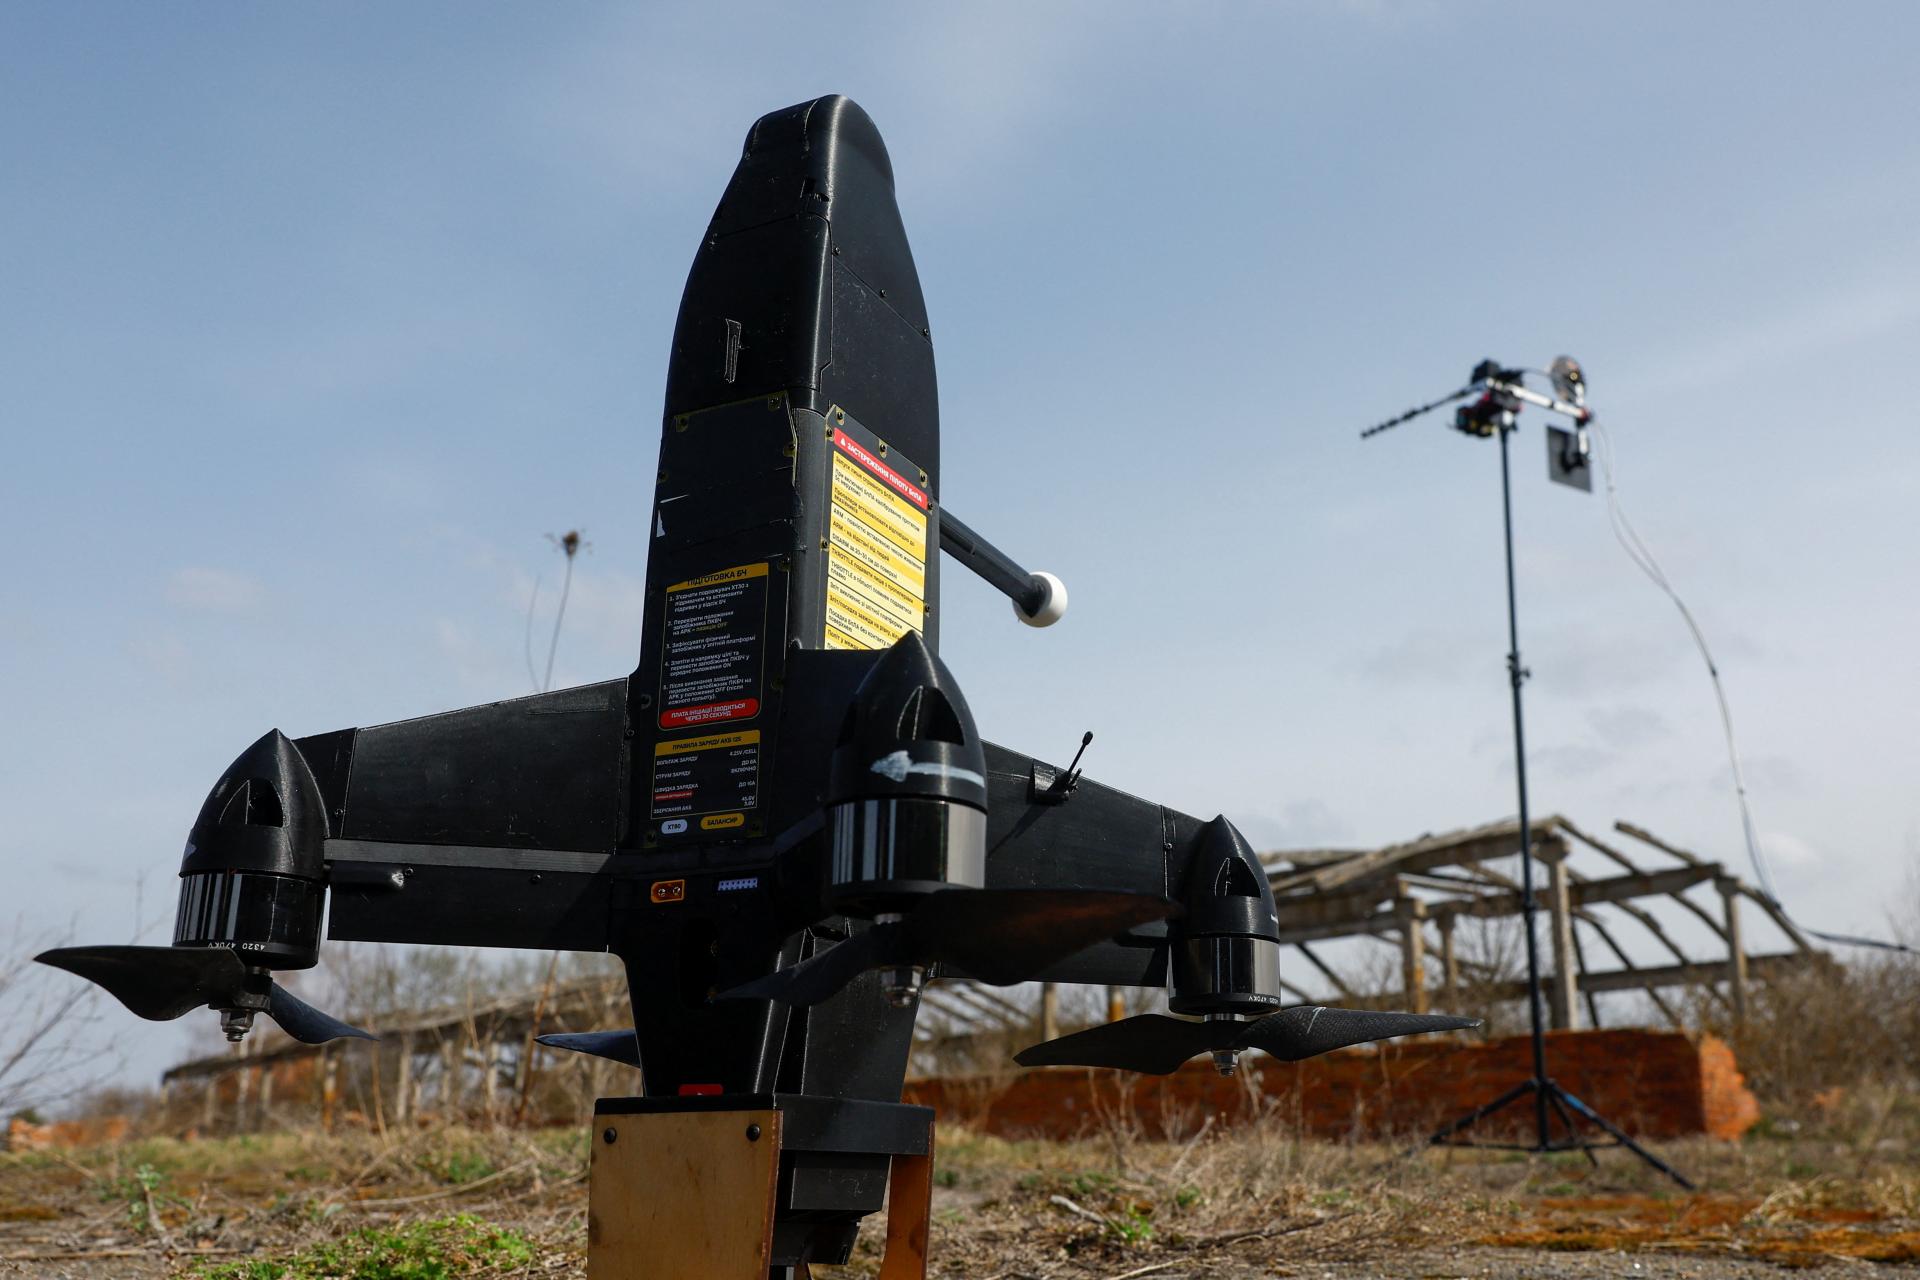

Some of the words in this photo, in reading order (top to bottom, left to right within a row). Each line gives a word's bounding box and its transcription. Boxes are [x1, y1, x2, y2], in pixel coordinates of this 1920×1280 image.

[847, 442, 889, 478] ЗАСТЕРЕЖЕННЯ
[890, 474, 908, 492] ПІЛОТУ
[909, 488, 922, 503] БпЛА
[864, 488, 874, 500] БпЛА
[884, 490, 894, 502] БпЛА
[834, 508, 843, 519] ARM
[833, 520, 843, 531] ARM
[832, 548, 853, 566] THROTTLE
[832, 561, 852, 579] THROTTLE
[688, 571, 735, 586] ПІДГОТОВКА
[848, 619, 859, 630] БпЛА
[242, 942, 265, 951] 4320
